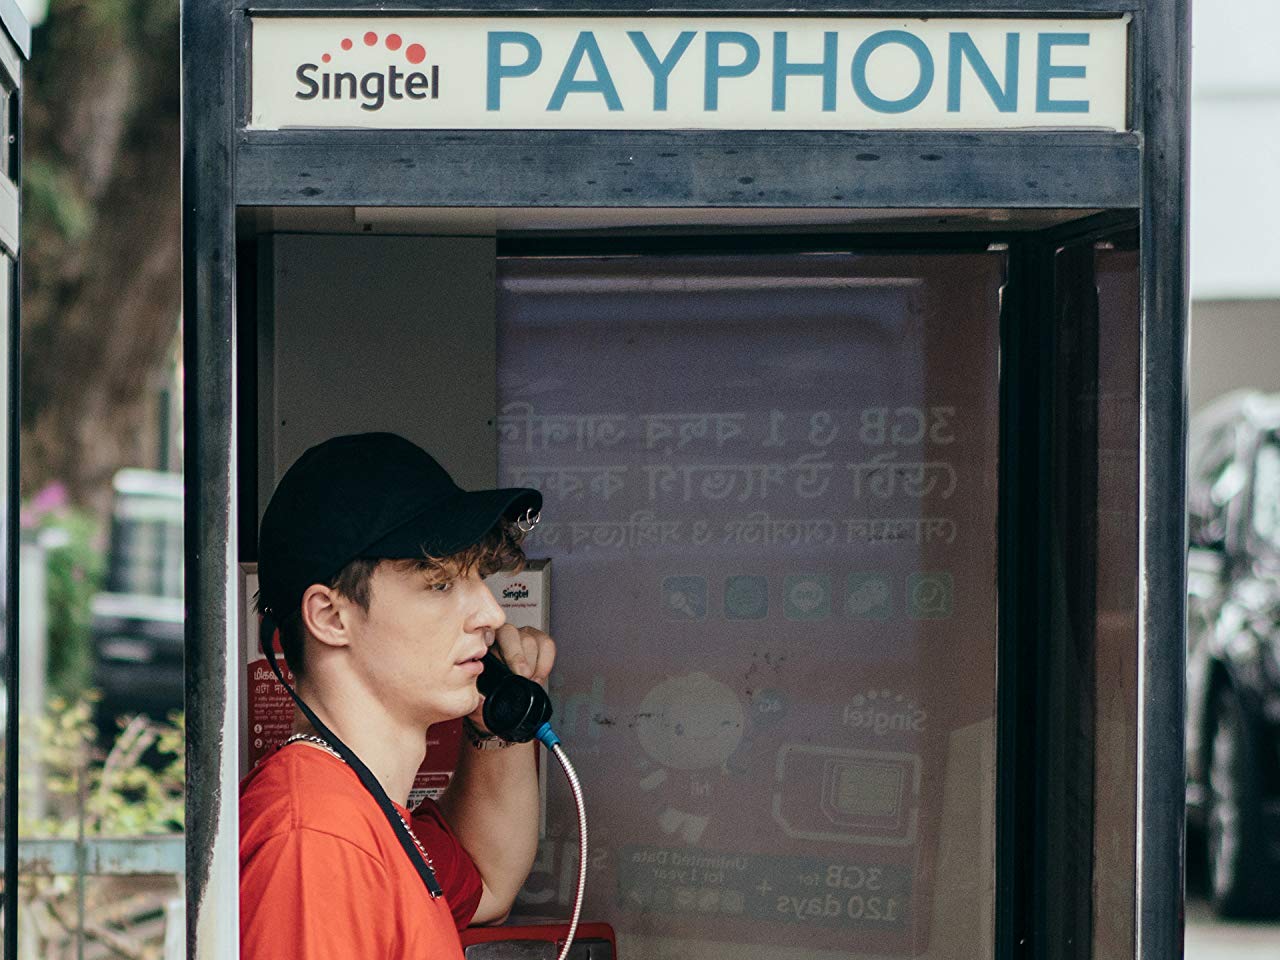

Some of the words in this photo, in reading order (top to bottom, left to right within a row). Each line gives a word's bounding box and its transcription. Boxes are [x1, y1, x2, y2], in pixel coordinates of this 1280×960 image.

[295, 63, 439, 112] Singtel
[485, 30, 1091, 114] PAYPHONE
[502, 589, 529, 601] Singtel
